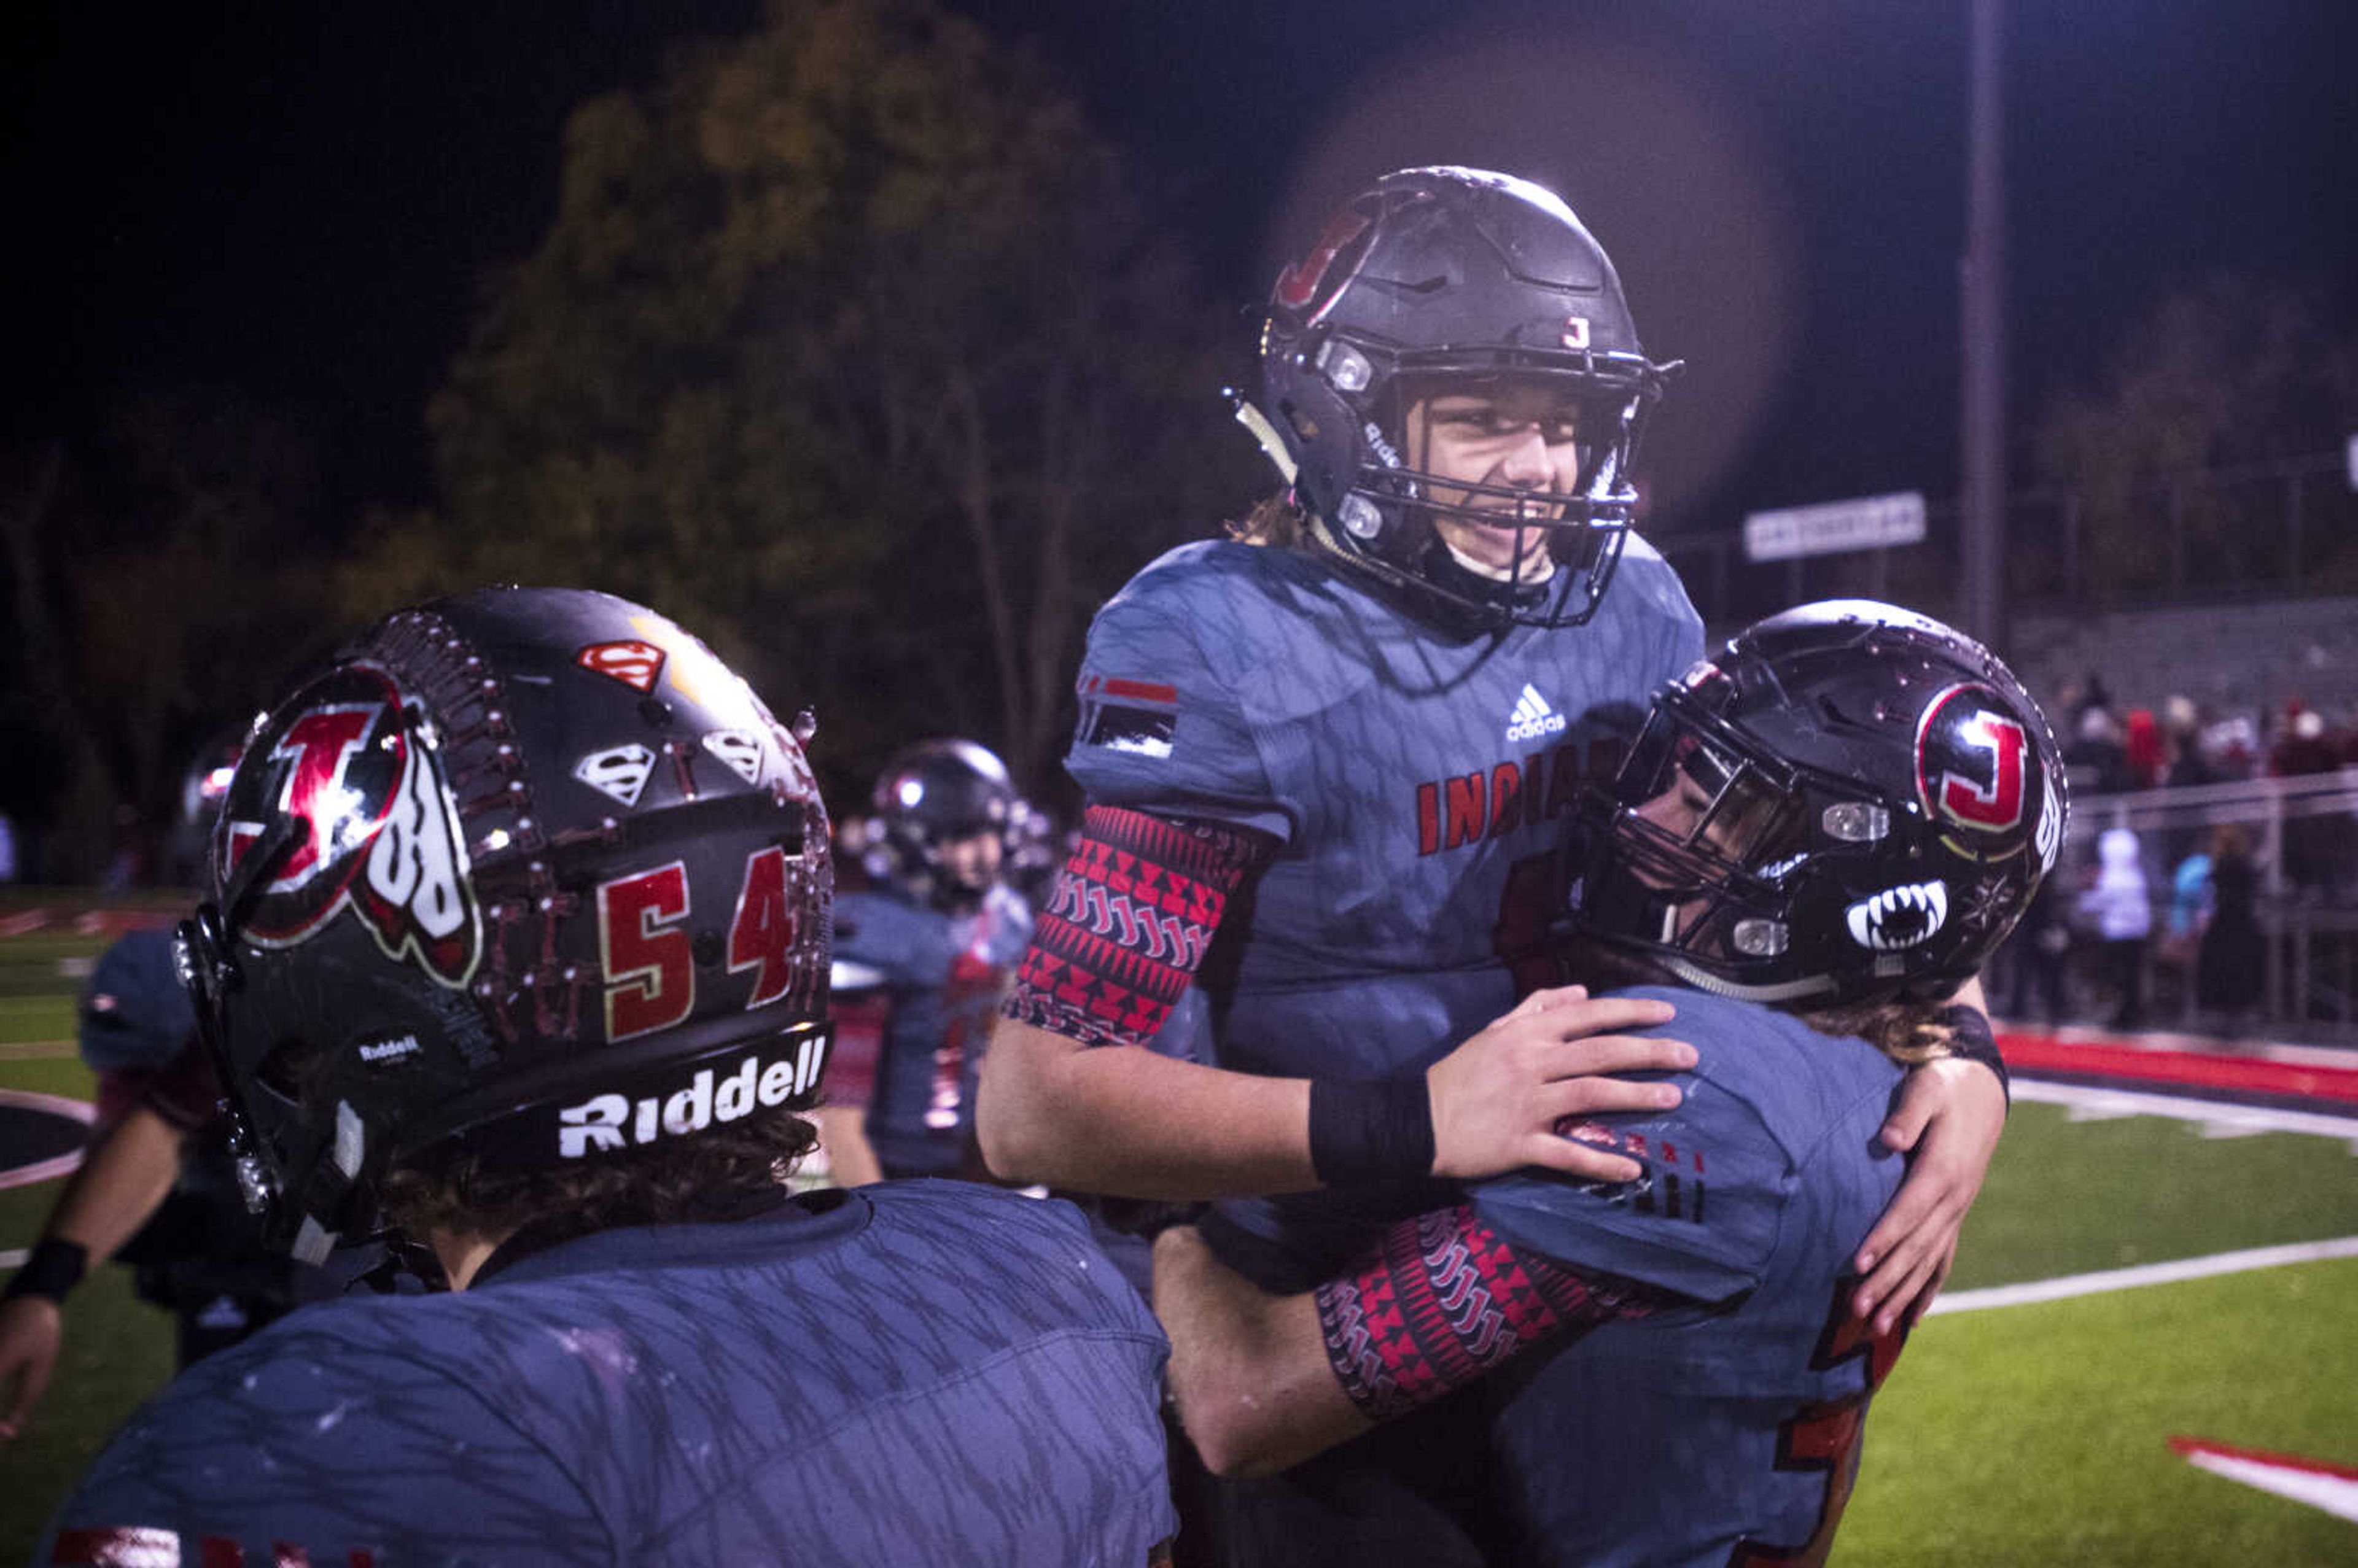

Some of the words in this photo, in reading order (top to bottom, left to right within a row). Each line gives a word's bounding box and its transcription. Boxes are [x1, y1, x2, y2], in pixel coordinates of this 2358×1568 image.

[1506, 714, 1566, 742] adidas
[1939, 709, 2028, 833] J
[359, 1034, 418, 1062] Riddell
[558, 1036, 826, 1159] Riddell
